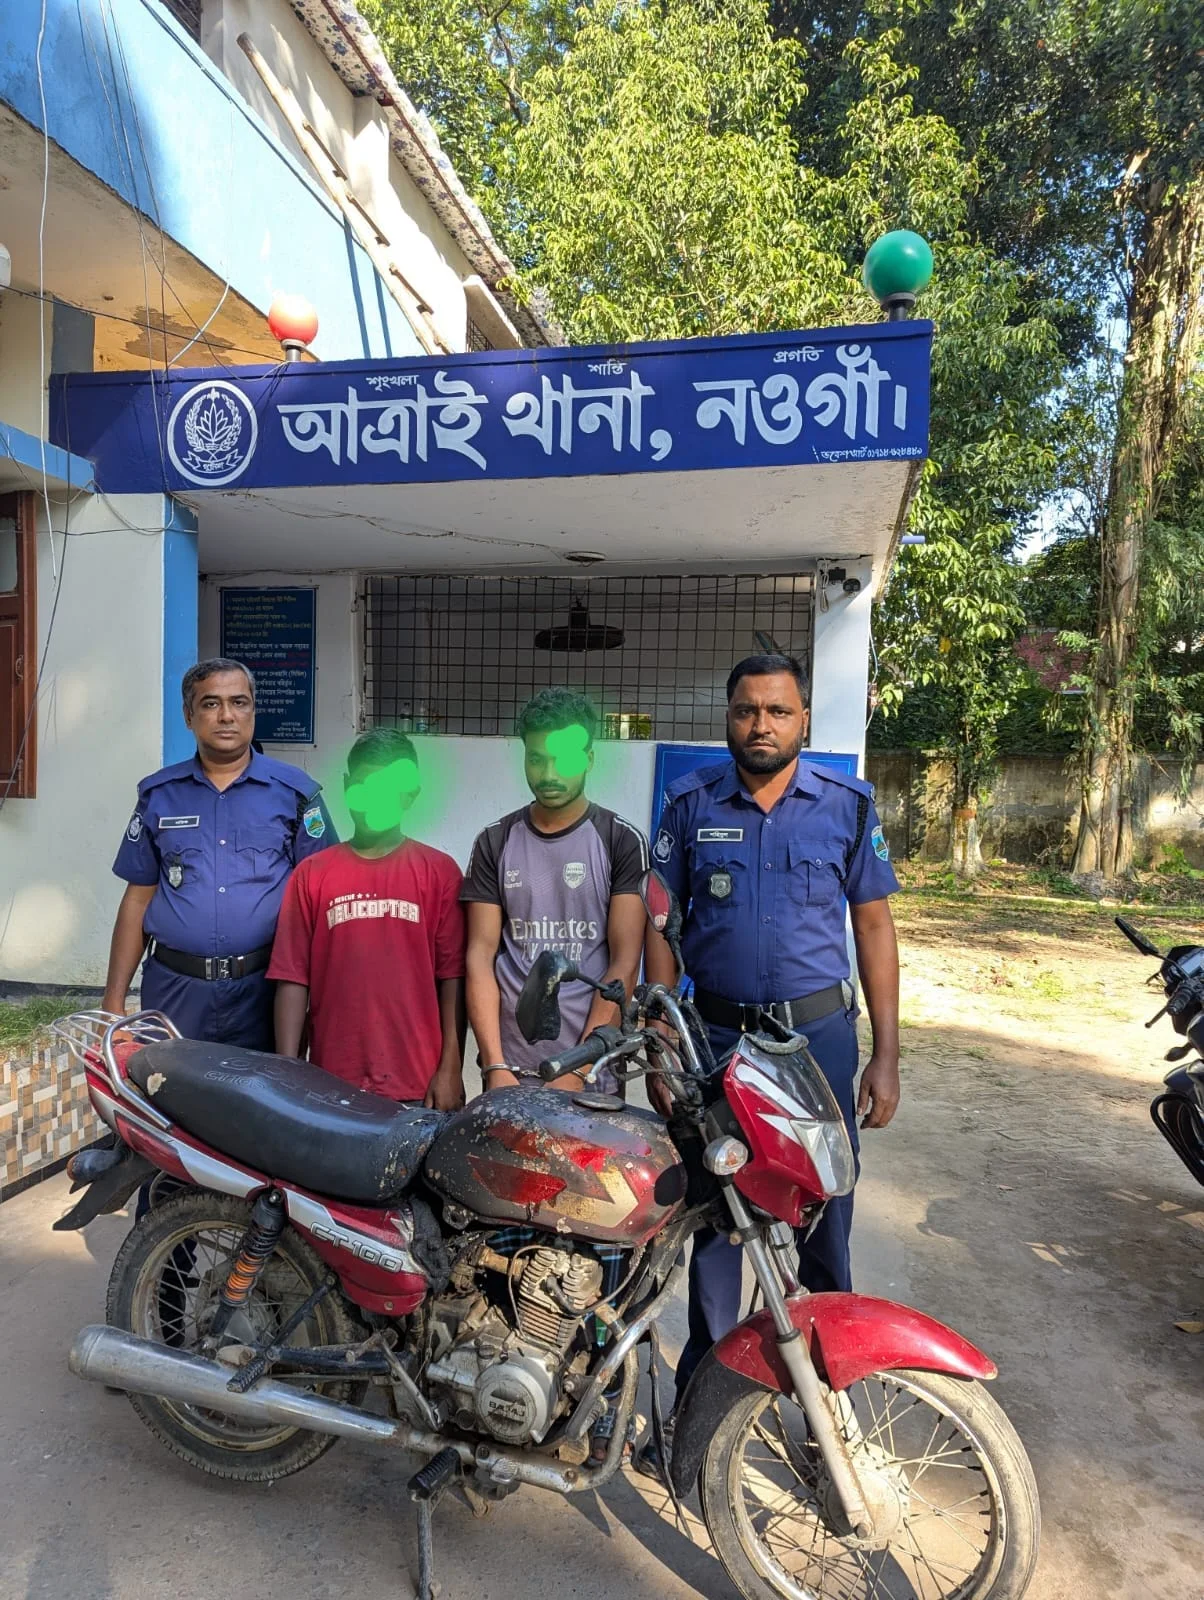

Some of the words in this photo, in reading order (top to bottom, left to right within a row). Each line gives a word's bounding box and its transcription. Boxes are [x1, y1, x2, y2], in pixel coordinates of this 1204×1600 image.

[587, 359, 627, 376] শান্তি
[773, 346, 824, 363] প্রগতি
[277, 370, 489, 471] আত্রাই
[502, 370, 673, 461] থানা,
[326, 899, 420, 930] HELICOPTER
[510, 916, 598, 940] Emirates
